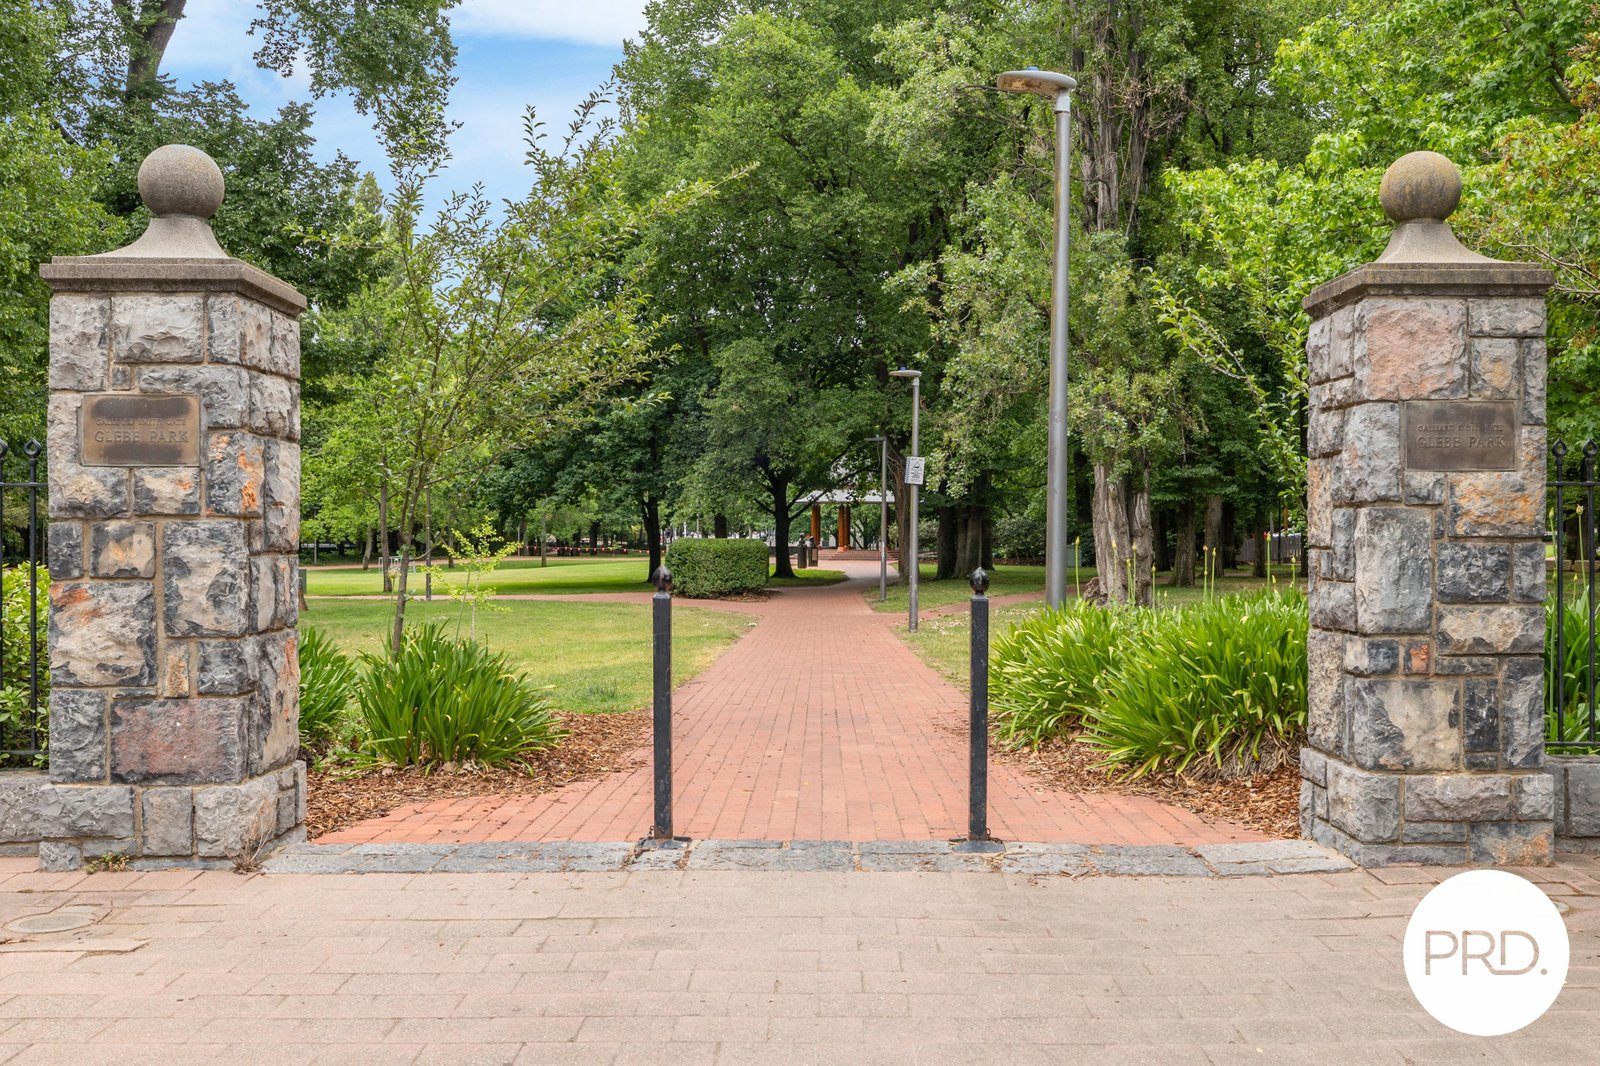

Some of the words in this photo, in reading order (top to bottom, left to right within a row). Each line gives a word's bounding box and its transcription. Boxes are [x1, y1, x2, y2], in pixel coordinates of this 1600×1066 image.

[94, 430, 141, 443] GLEBE
[149, 430, 189, 443] PARK
[1417, 436, 1460, 449] GLEBE
[1468, 435, 1506, 449] PARK
